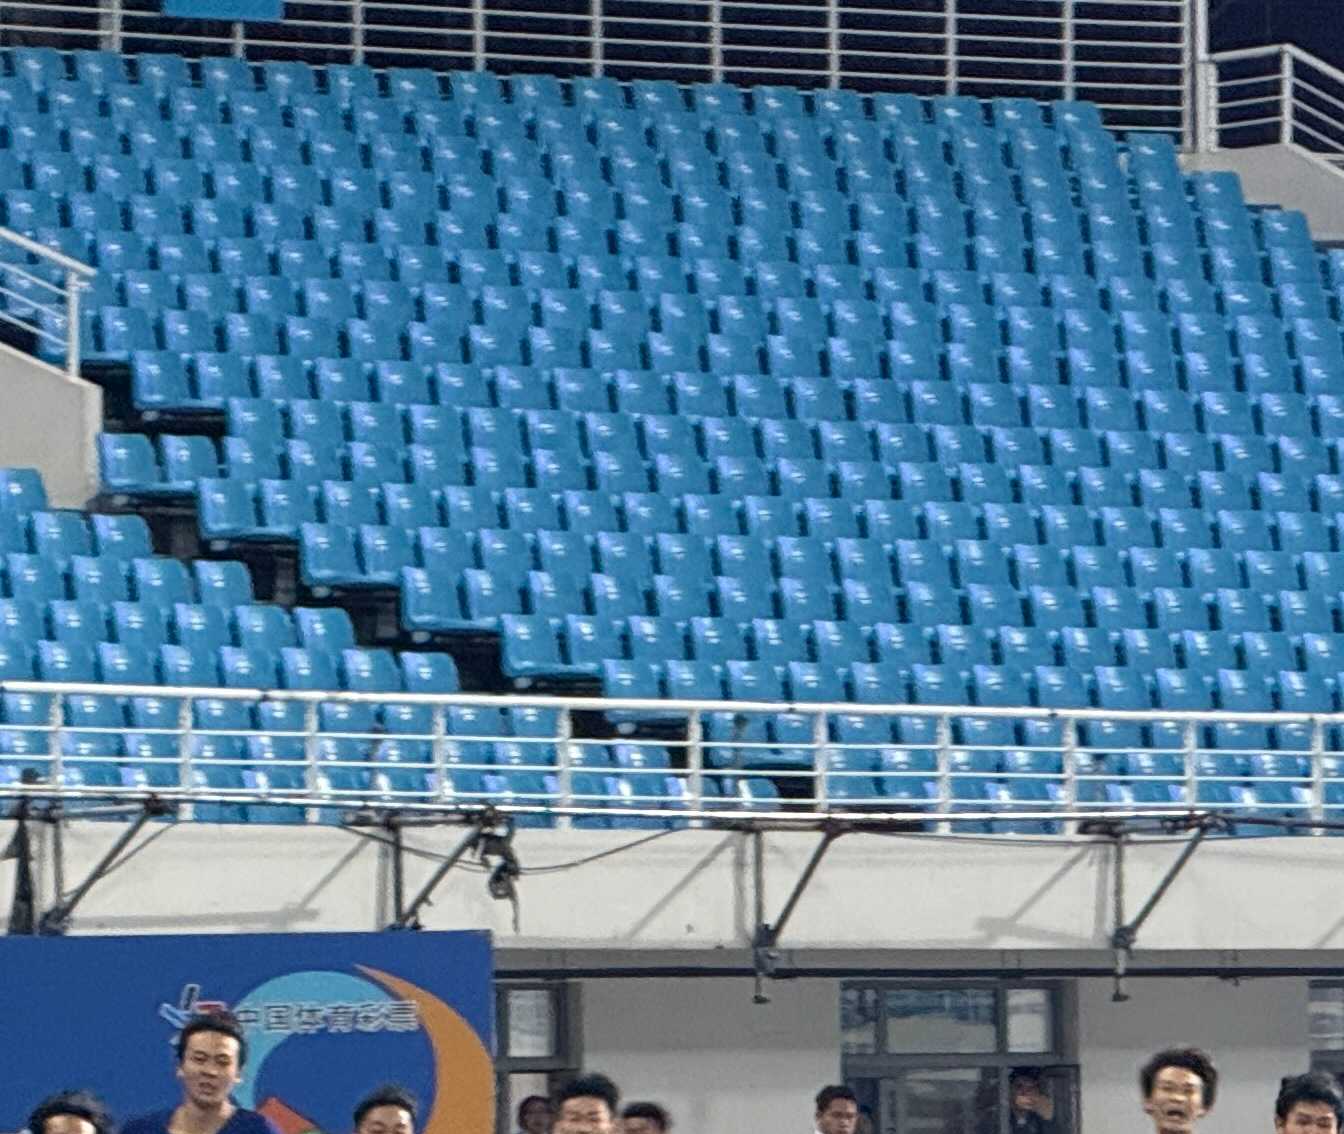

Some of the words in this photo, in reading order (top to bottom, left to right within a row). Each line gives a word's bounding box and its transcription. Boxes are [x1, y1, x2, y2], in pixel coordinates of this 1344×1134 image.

[236, 1000, 419, 1035] 中国体育彩票
